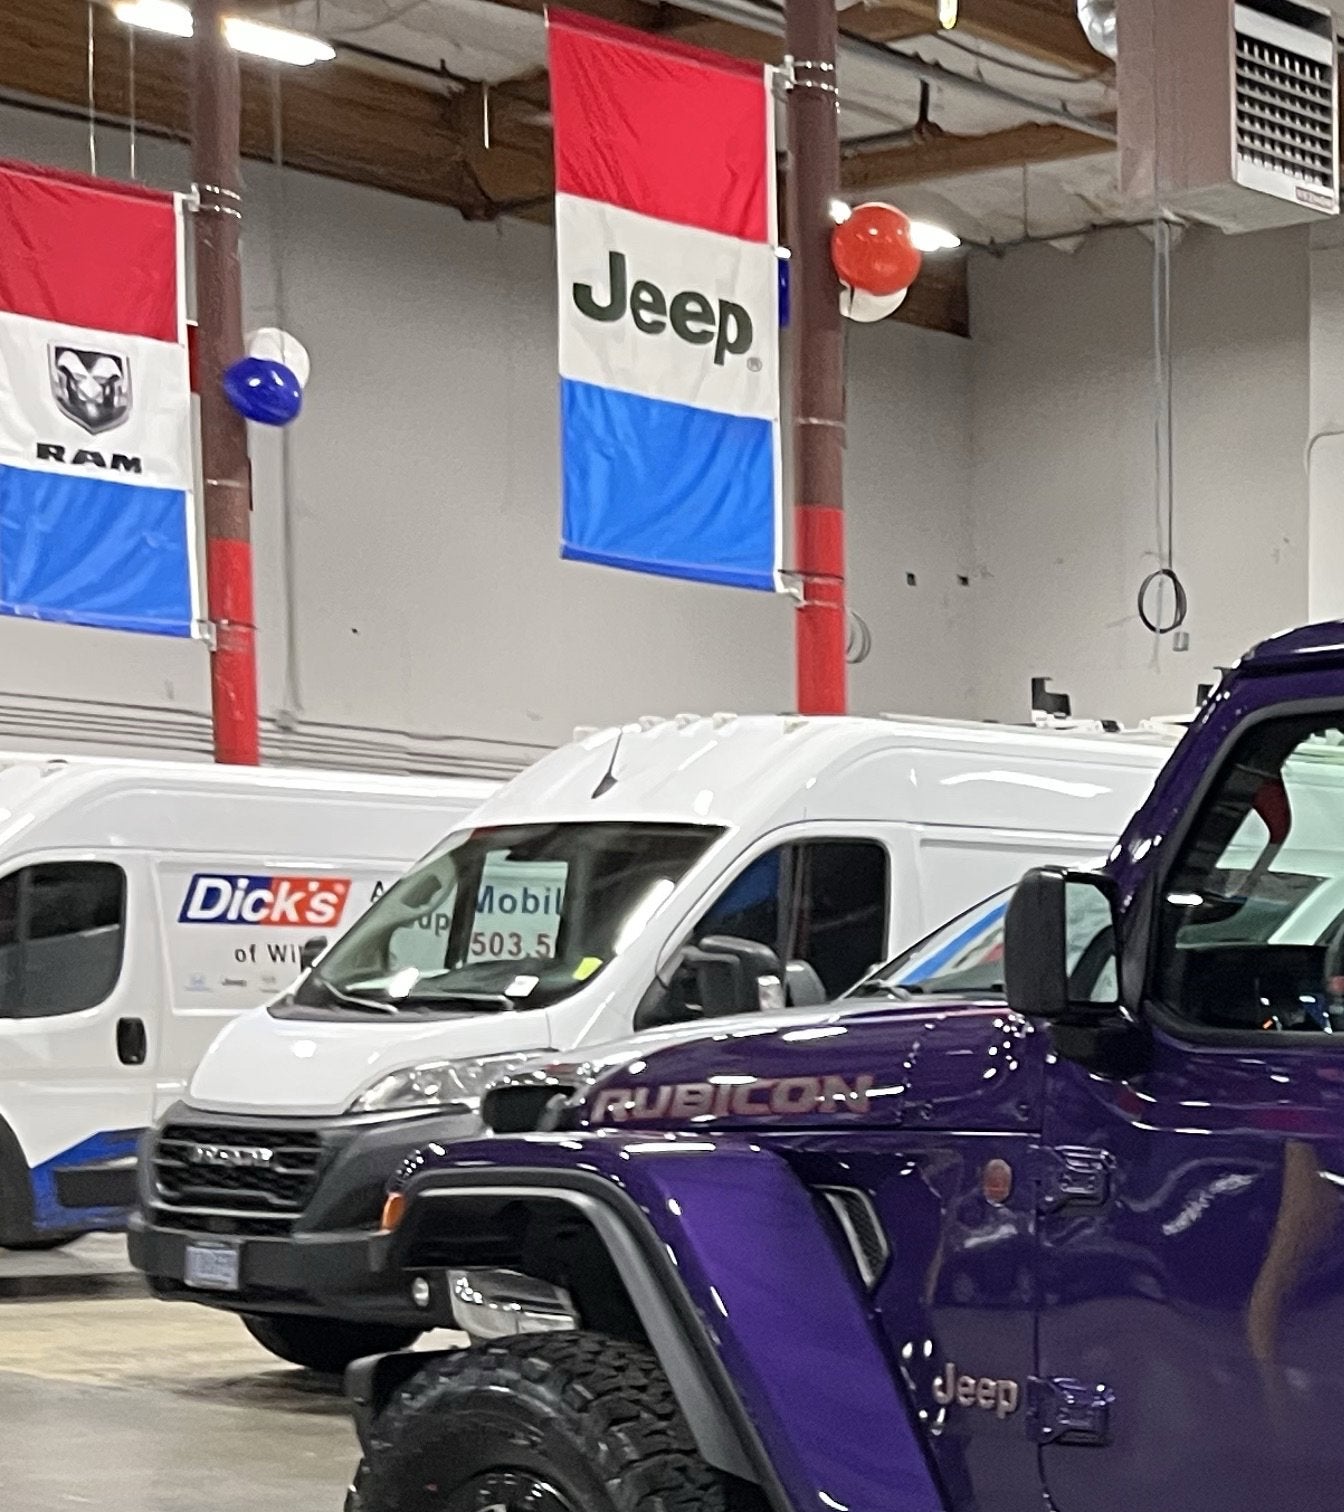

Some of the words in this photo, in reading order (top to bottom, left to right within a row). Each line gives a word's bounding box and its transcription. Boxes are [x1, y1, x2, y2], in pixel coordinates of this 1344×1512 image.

[572, 250, 754, 367] Jeep
[36, 442, 142, 475] RAM
[186, 876, 341, 925] Dick's
[476, 885, 562, 915] Mobil
[591, 1074, 874, 1123] RUBICON
[932, 1362, 1018, 1419] Jeep
